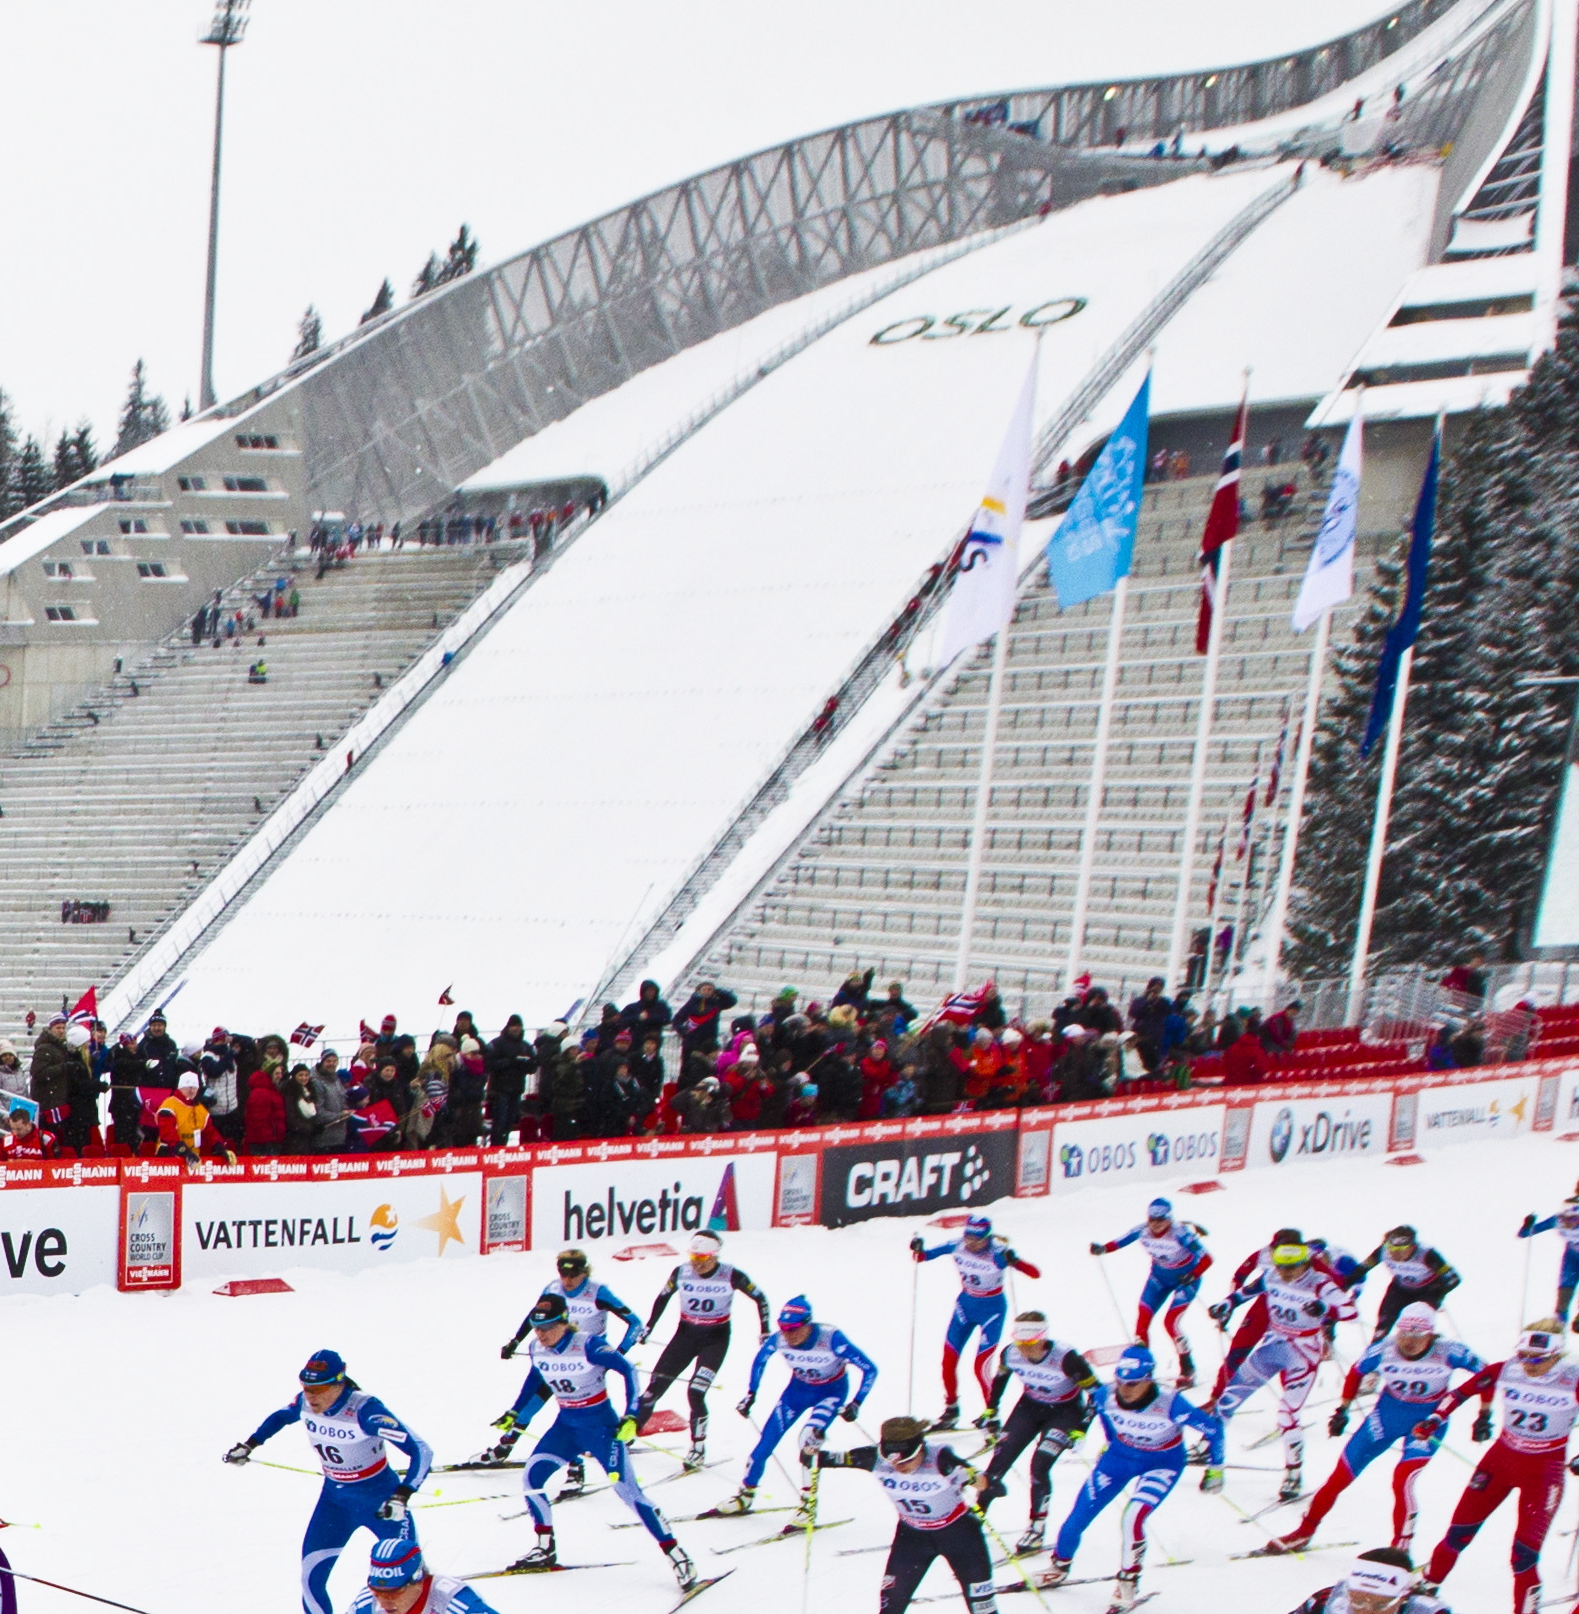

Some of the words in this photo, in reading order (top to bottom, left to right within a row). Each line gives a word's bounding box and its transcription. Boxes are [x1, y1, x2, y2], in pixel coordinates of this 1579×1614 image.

[869, 297, 1088, 344] OSLO
[1297, 1109, 1372, 1156] xDrive
[1088, 1141, 1137, 1174] OBOS
[1174, 1131, 1219, 1162] OBOS
[124, 1161, 180, 1184] VIESSMANN
[252, 1159, 307, 1180] VIESSMANN
[312, 1158, 369, 1180] VIESSMANN
[376, 1154, 426, 1176] VIESSMANN
[431, 1151, 478, 1173] VIESSMANN
[51, 1162, 117, 1186] VIESSMANN
[846, 1151, 962, 1209] CRAFT
[564, 1182, 704, 1241] helvetia
[130, 1232, 156, 1243] CROSS
[195, 1215, 362, 1251] VATTENFALL
[130, 1241, 167, 1253] COUNTRY
[130, 1252, 151, 1262] WORLD
[696, 1284, 728, 1294] OBOS
[688, 1298, 715, 1313] 20
[552, 1361, 584, 1372] OBOS
[550, 1378, 576, 1394] 18
[1509, 1409, 1549, 1432] 23
[319, 1425, 356, 1440] OBOS
[314, 1443, 344, 1465] 16
[900, 1480, 942, 1492] OBOS
[898, 1498, 932, 1515] 15
